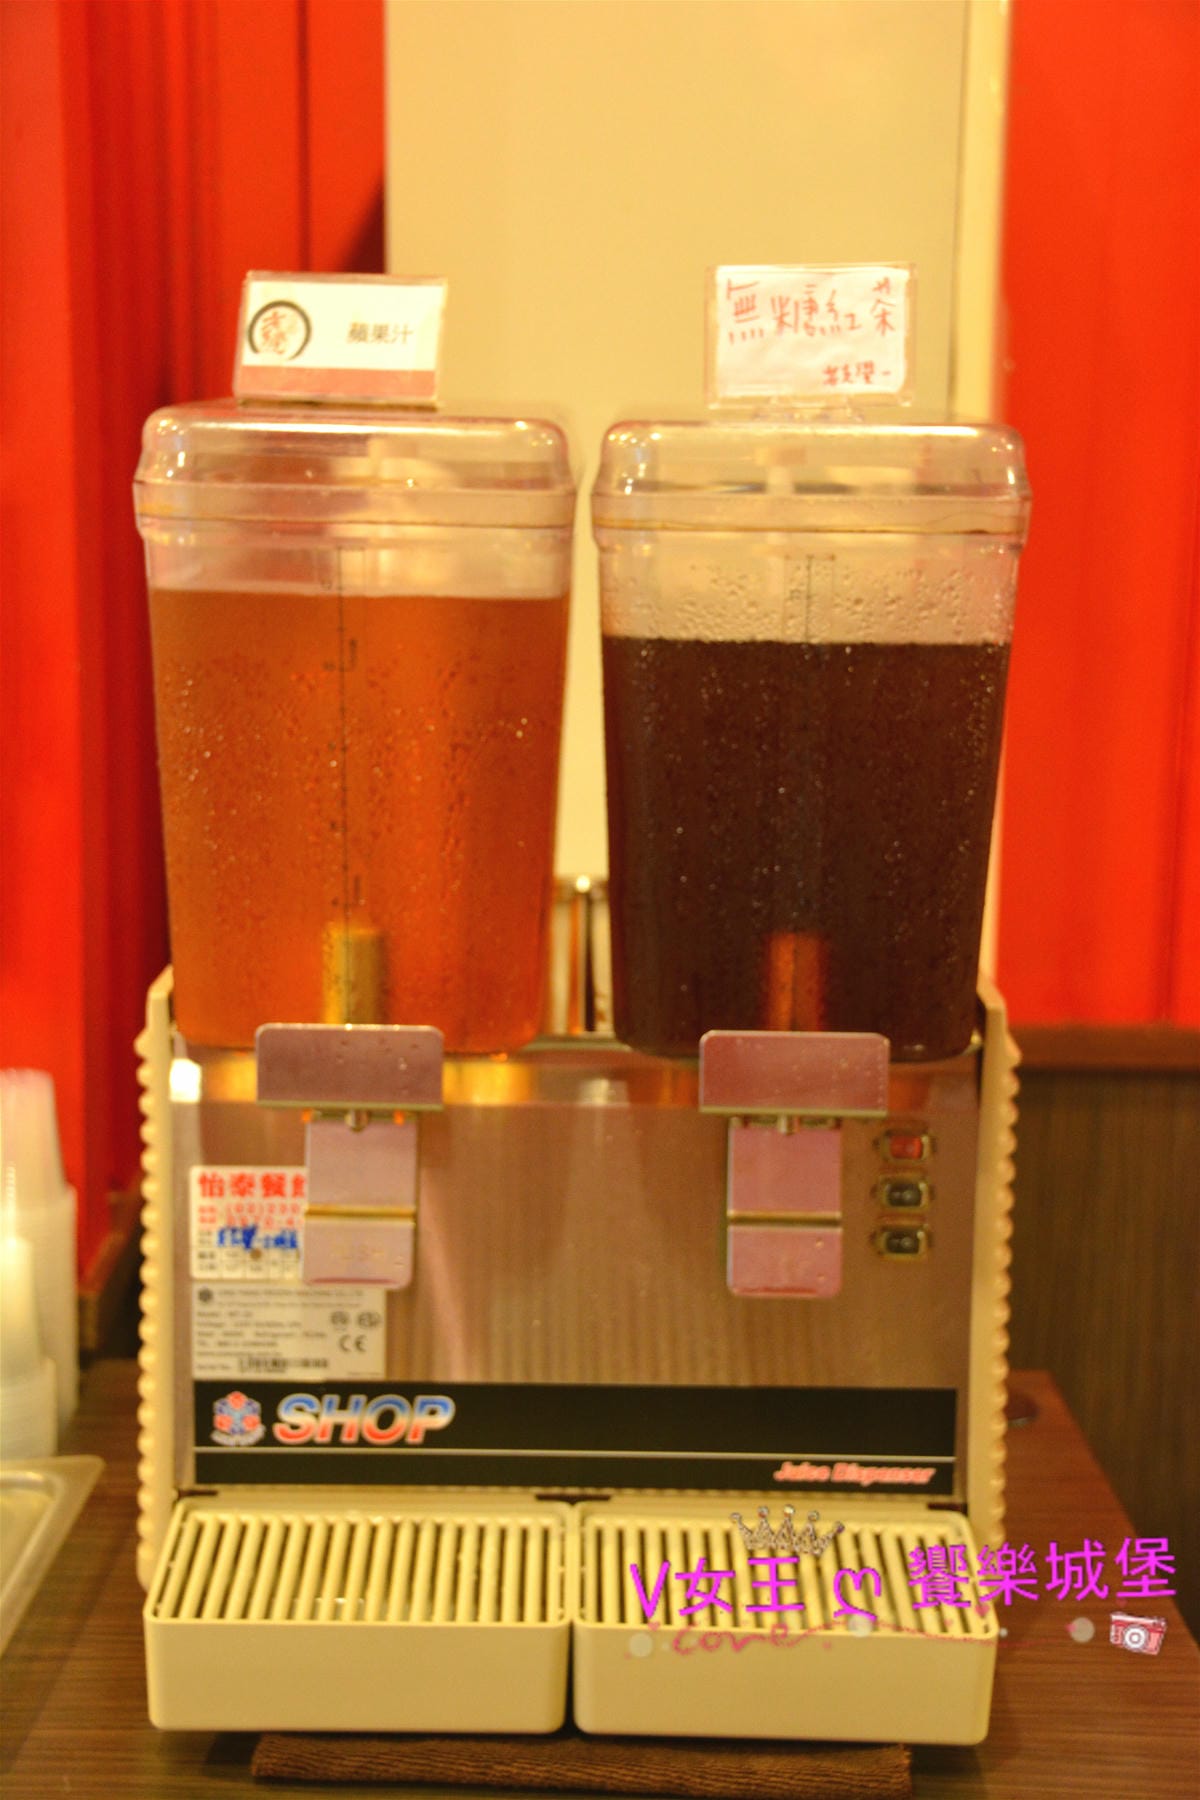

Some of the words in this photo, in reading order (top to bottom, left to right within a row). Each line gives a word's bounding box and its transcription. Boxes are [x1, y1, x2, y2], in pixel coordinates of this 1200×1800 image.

[726, 276, 896, 344] 無糖紅茶
[346, 322, 413, 345] 蘋果汁
[273, 1393, 456, 1445] SHOP
[773, 1461, 831, 1482] Juice
